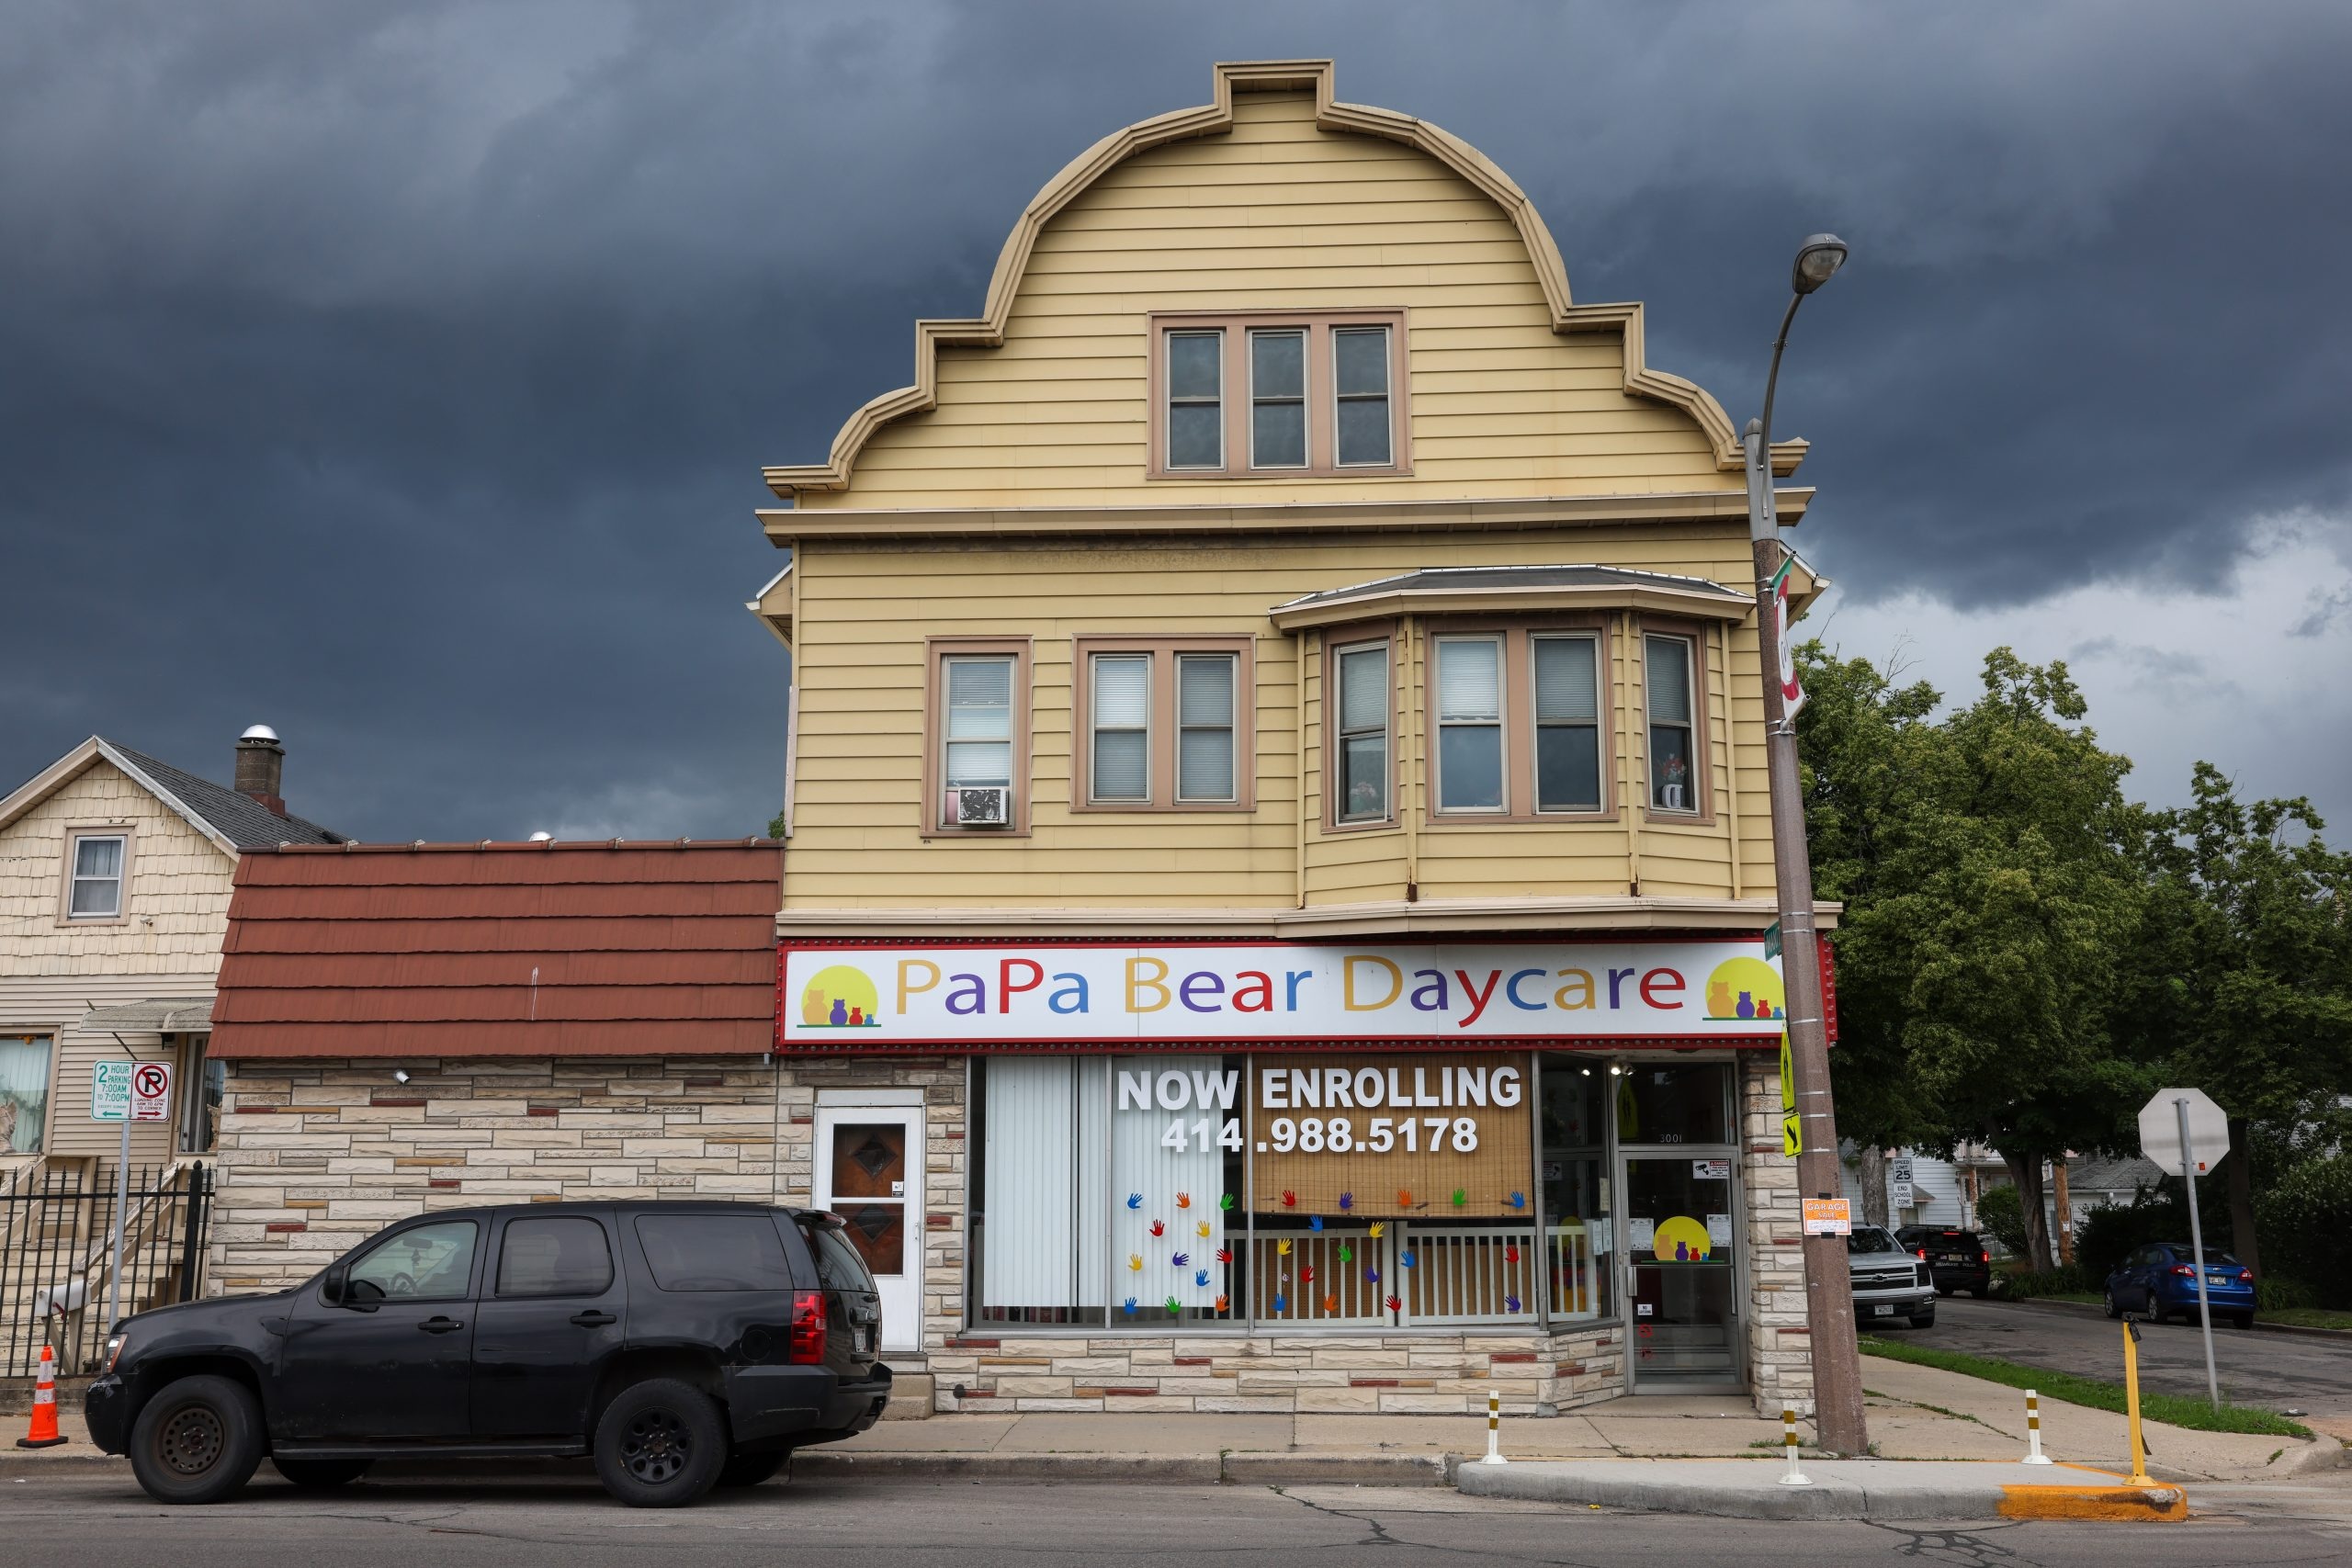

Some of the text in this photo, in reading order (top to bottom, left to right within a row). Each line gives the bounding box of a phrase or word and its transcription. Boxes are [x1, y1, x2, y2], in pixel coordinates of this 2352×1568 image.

[898, 955, 1686, 1027] PaPa Bear Daycare
[98, 1065, 130, 1083] 2 HOUR
[107, 1076, 131, 1084] PARKING
[102, 1084, 127, 1092] 7:00AM
[1118, 1066, 1521, 1110] NOW ENROLLING
[105, 1093, 130, 1101] 7:00PM
[1660, 1134, 1682, 1143] 3001
[1895, 1170, 1911, 1179] 25
